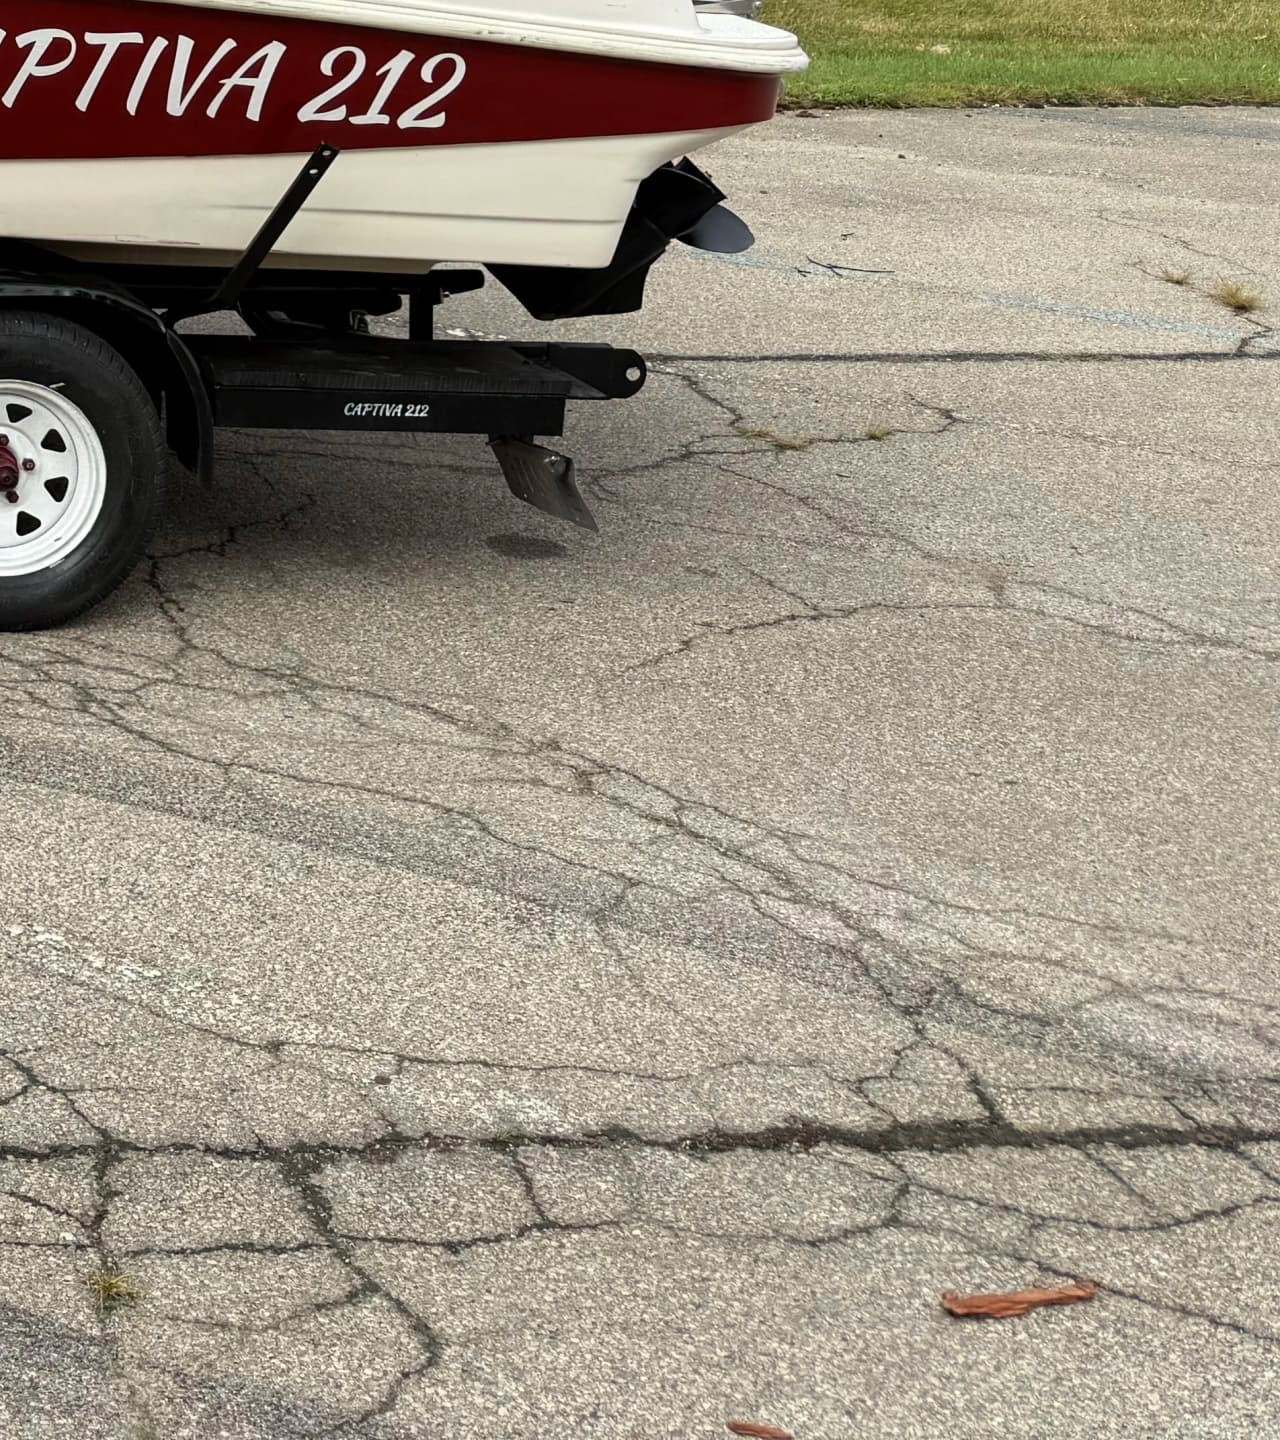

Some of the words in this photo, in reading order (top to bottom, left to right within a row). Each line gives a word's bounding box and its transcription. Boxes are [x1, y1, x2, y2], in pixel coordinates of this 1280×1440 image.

[296, 45, 467, 130] 212
[343, 402, 403, 417] CAPTIVA
[404, 404, 430, 417] 212
